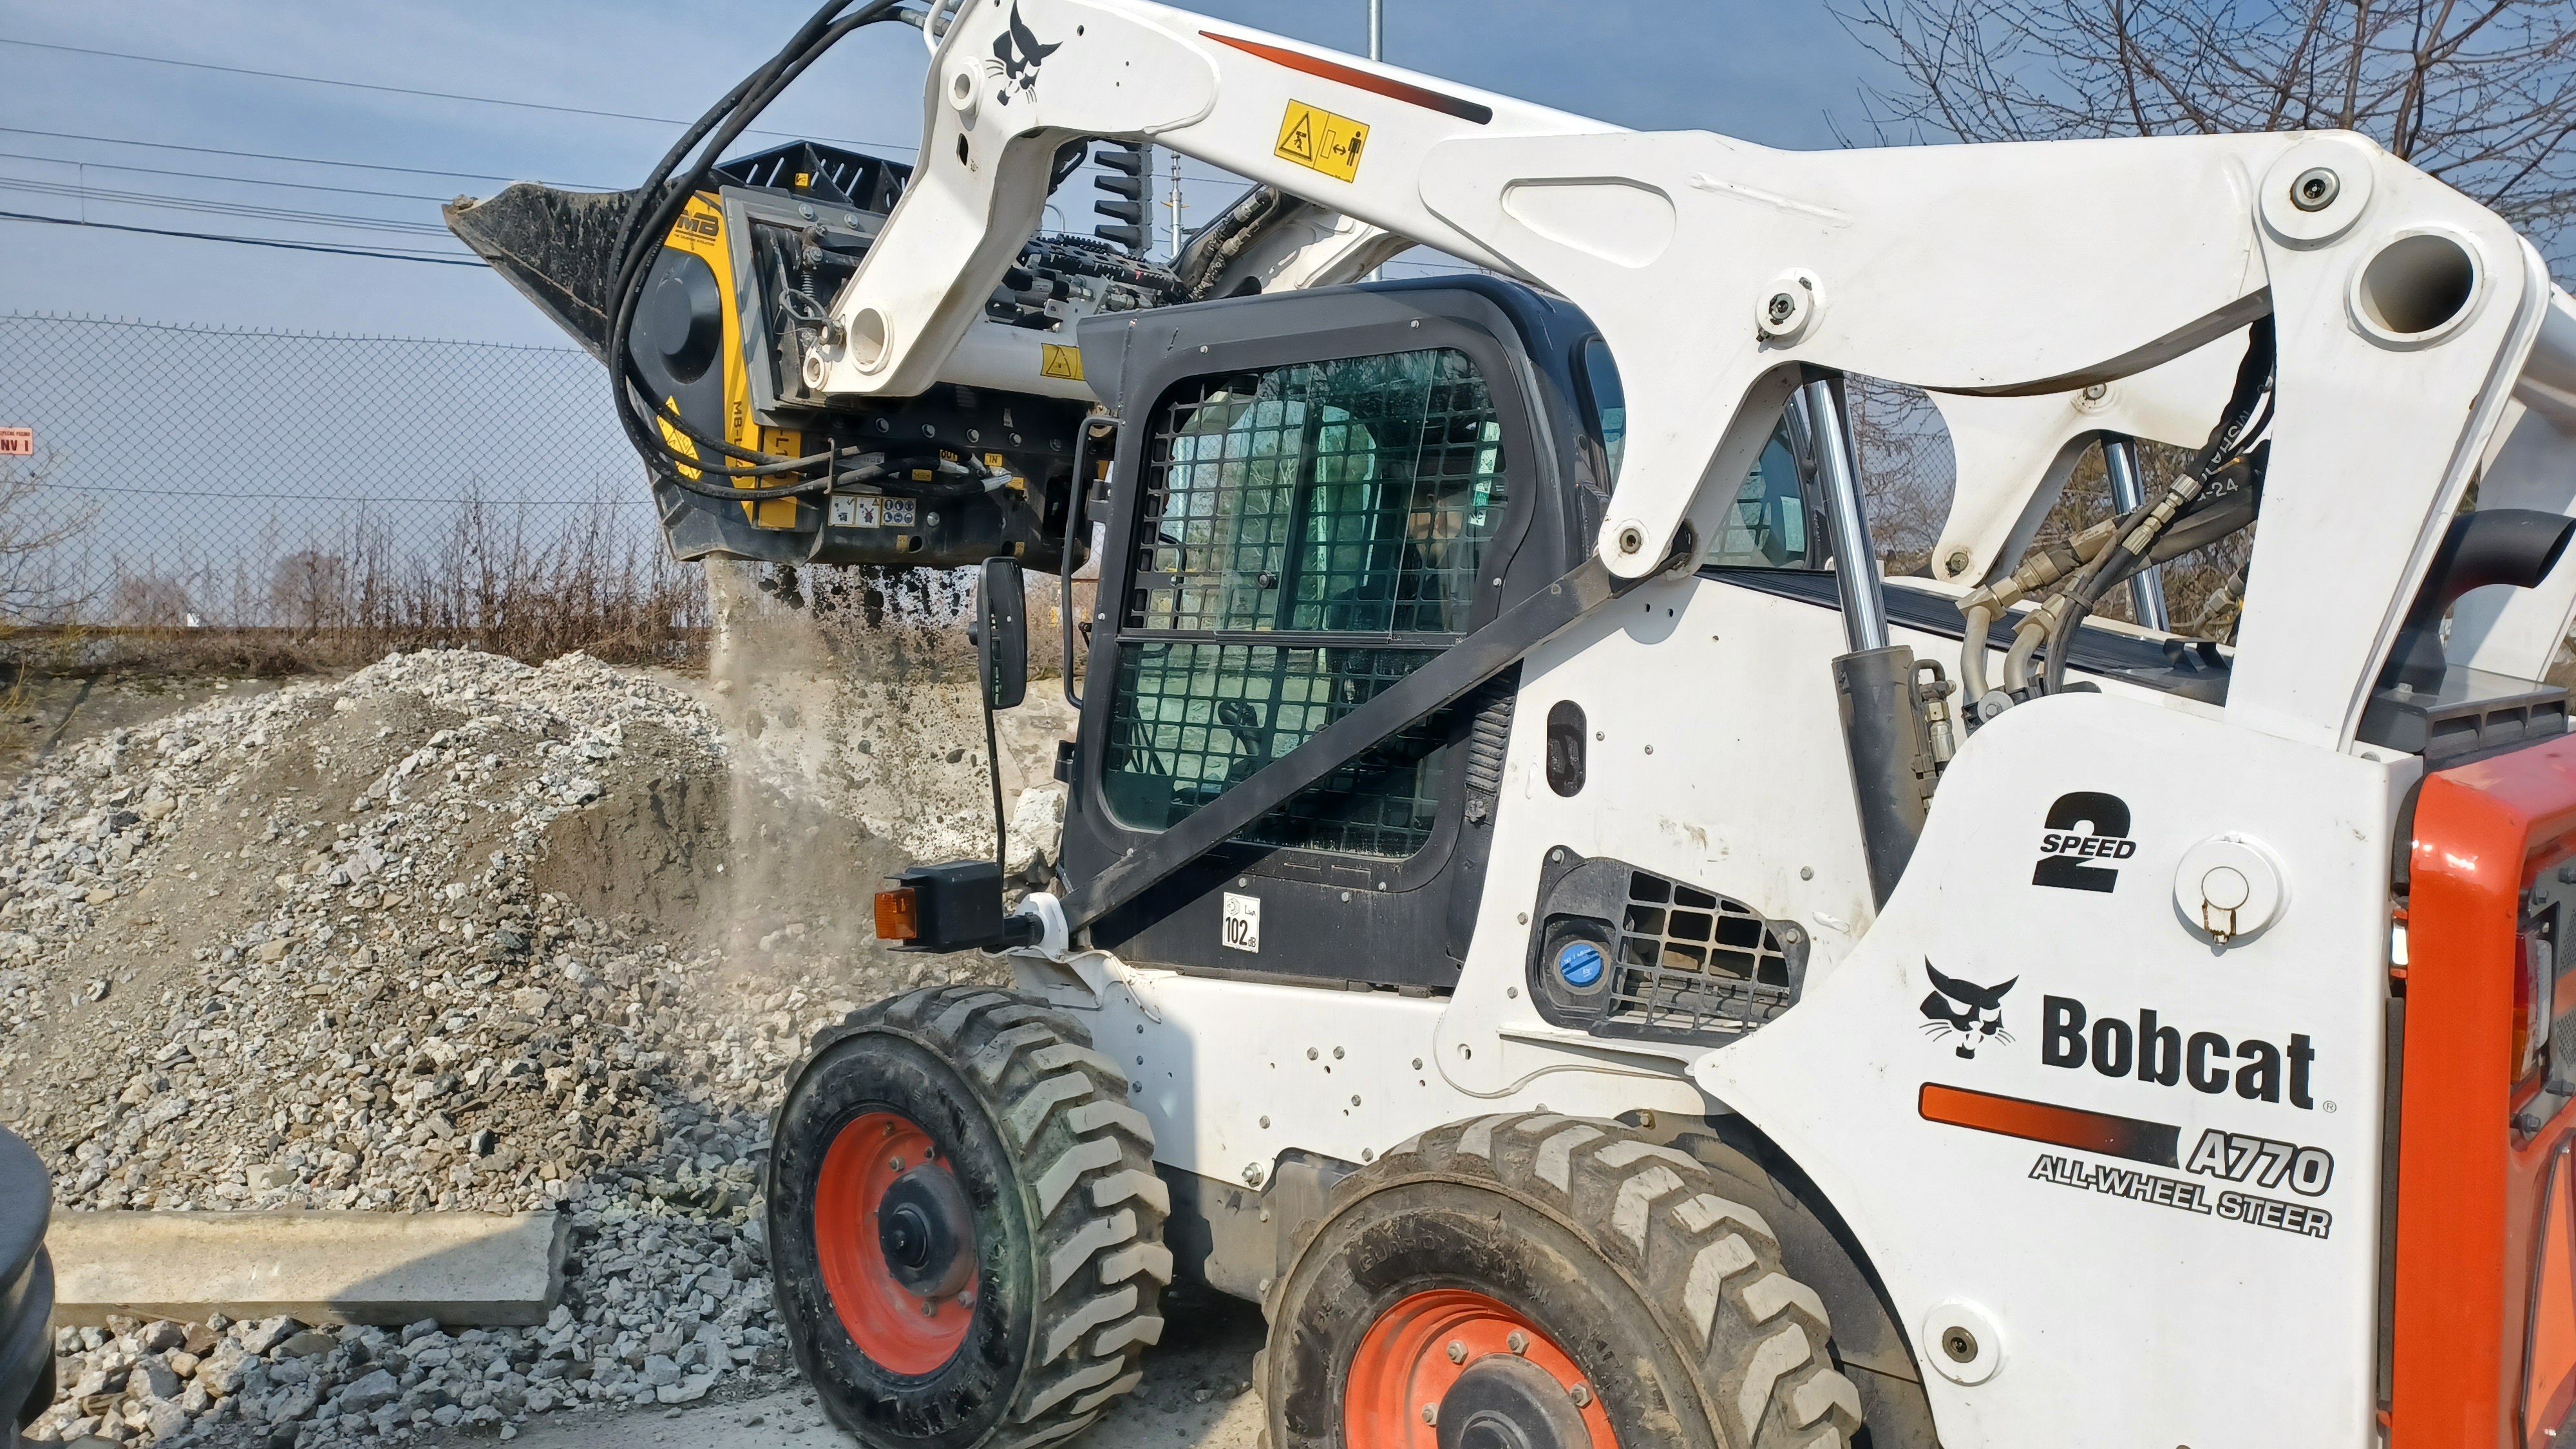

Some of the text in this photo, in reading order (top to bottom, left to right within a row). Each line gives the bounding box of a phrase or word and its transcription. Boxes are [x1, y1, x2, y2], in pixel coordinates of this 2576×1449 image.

[989, 455, 998, 464] IN
[2032, 791, 2131, 893] 2
[2040, 834, 2136, 859] SPEED
[1226, 916, 1256, 948] 102 dB
[2042, 994, 2315, 1110] Bobcat
[2029, 1155, 2333, 1239] ALL-WHEEL STEER
[2186, 1128, 2334, 1197] A770
